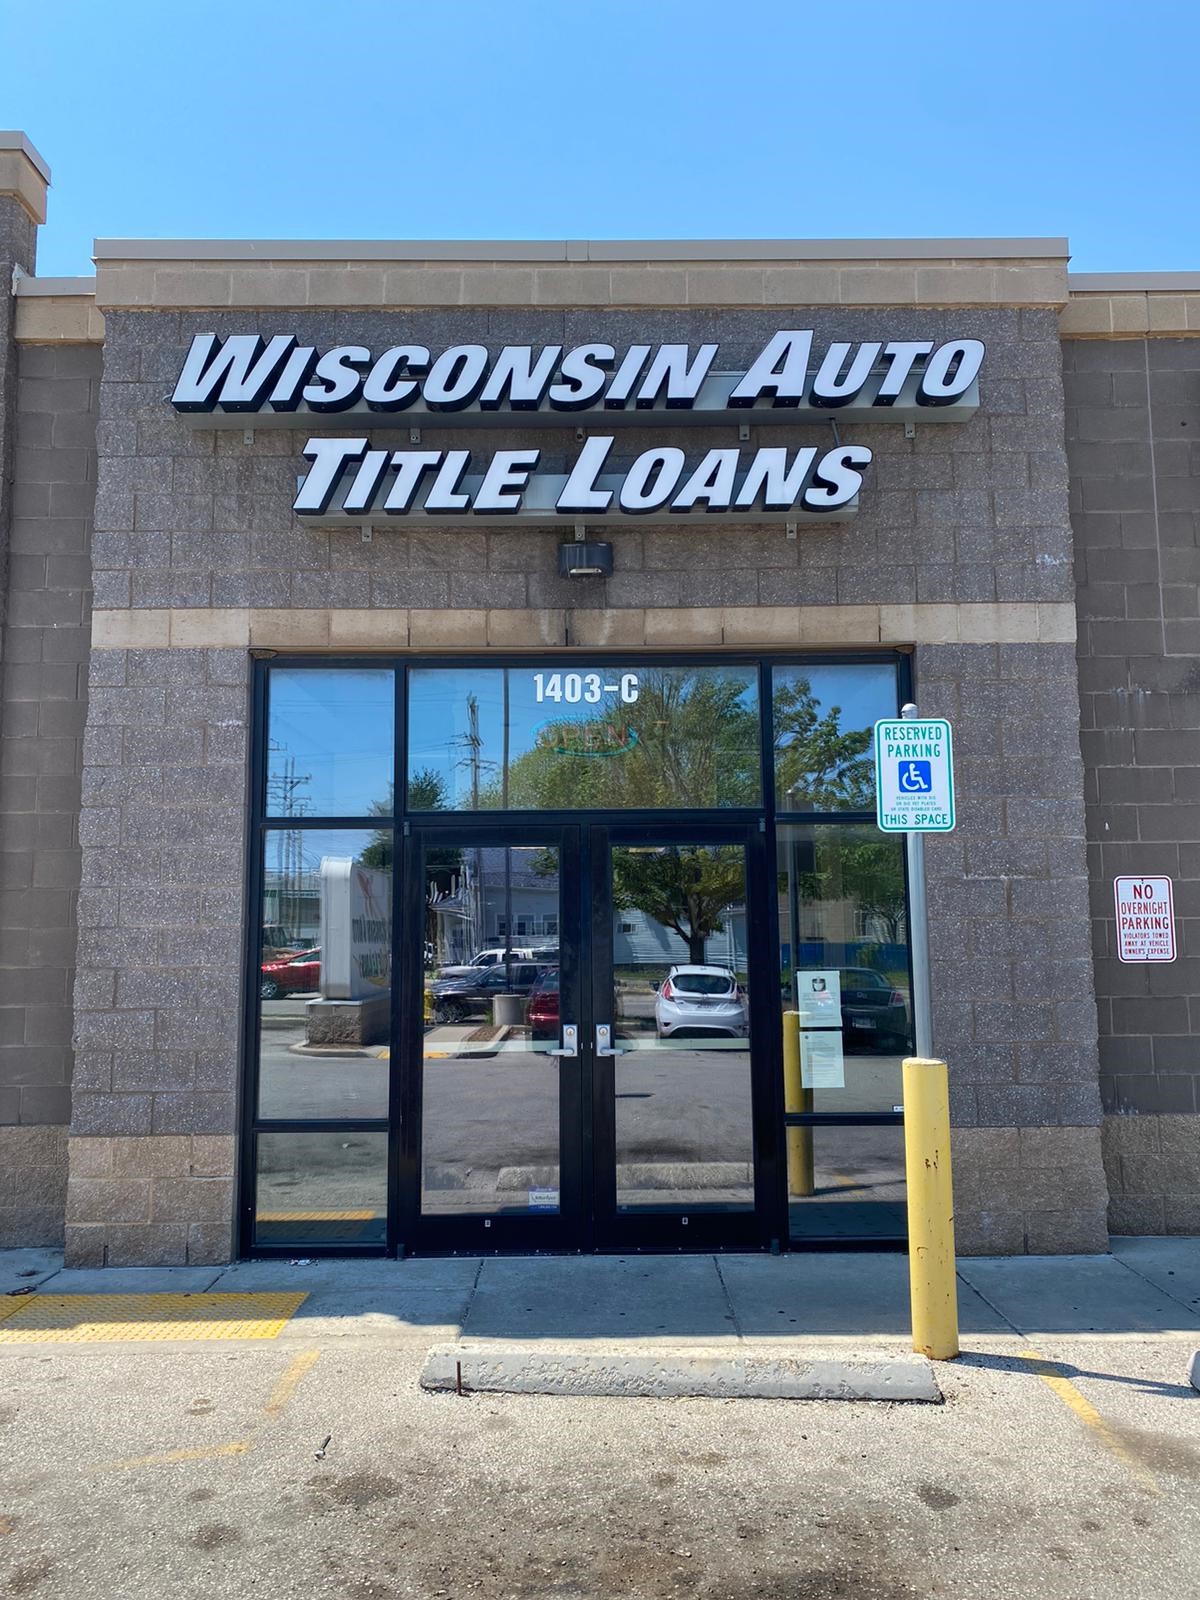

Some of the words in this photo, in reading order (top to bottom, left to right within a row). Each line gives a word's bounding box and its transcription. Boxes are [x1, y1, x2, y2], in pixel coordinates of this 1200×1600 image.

[171, 334, 719, 411] WISCONSIN
[728, 329, 986, 407] AUTO
[293, 437, 541, 514] TITLE
[556, 435, 872, 513] LOANS
[533, 673, 639, 703] 1403-C
[884, 726, 942, 741] RESERVED
[887, 743, 941, 758] PARKING
[884, 813, 908, 825] THIS
[914, 813, 948, 825] SPACE
[1133, 884, 1153, 899] NO
[1121, 902, 1168, 915] OVERNIGHT
[1122, 917, 1169, 930] PARKING
